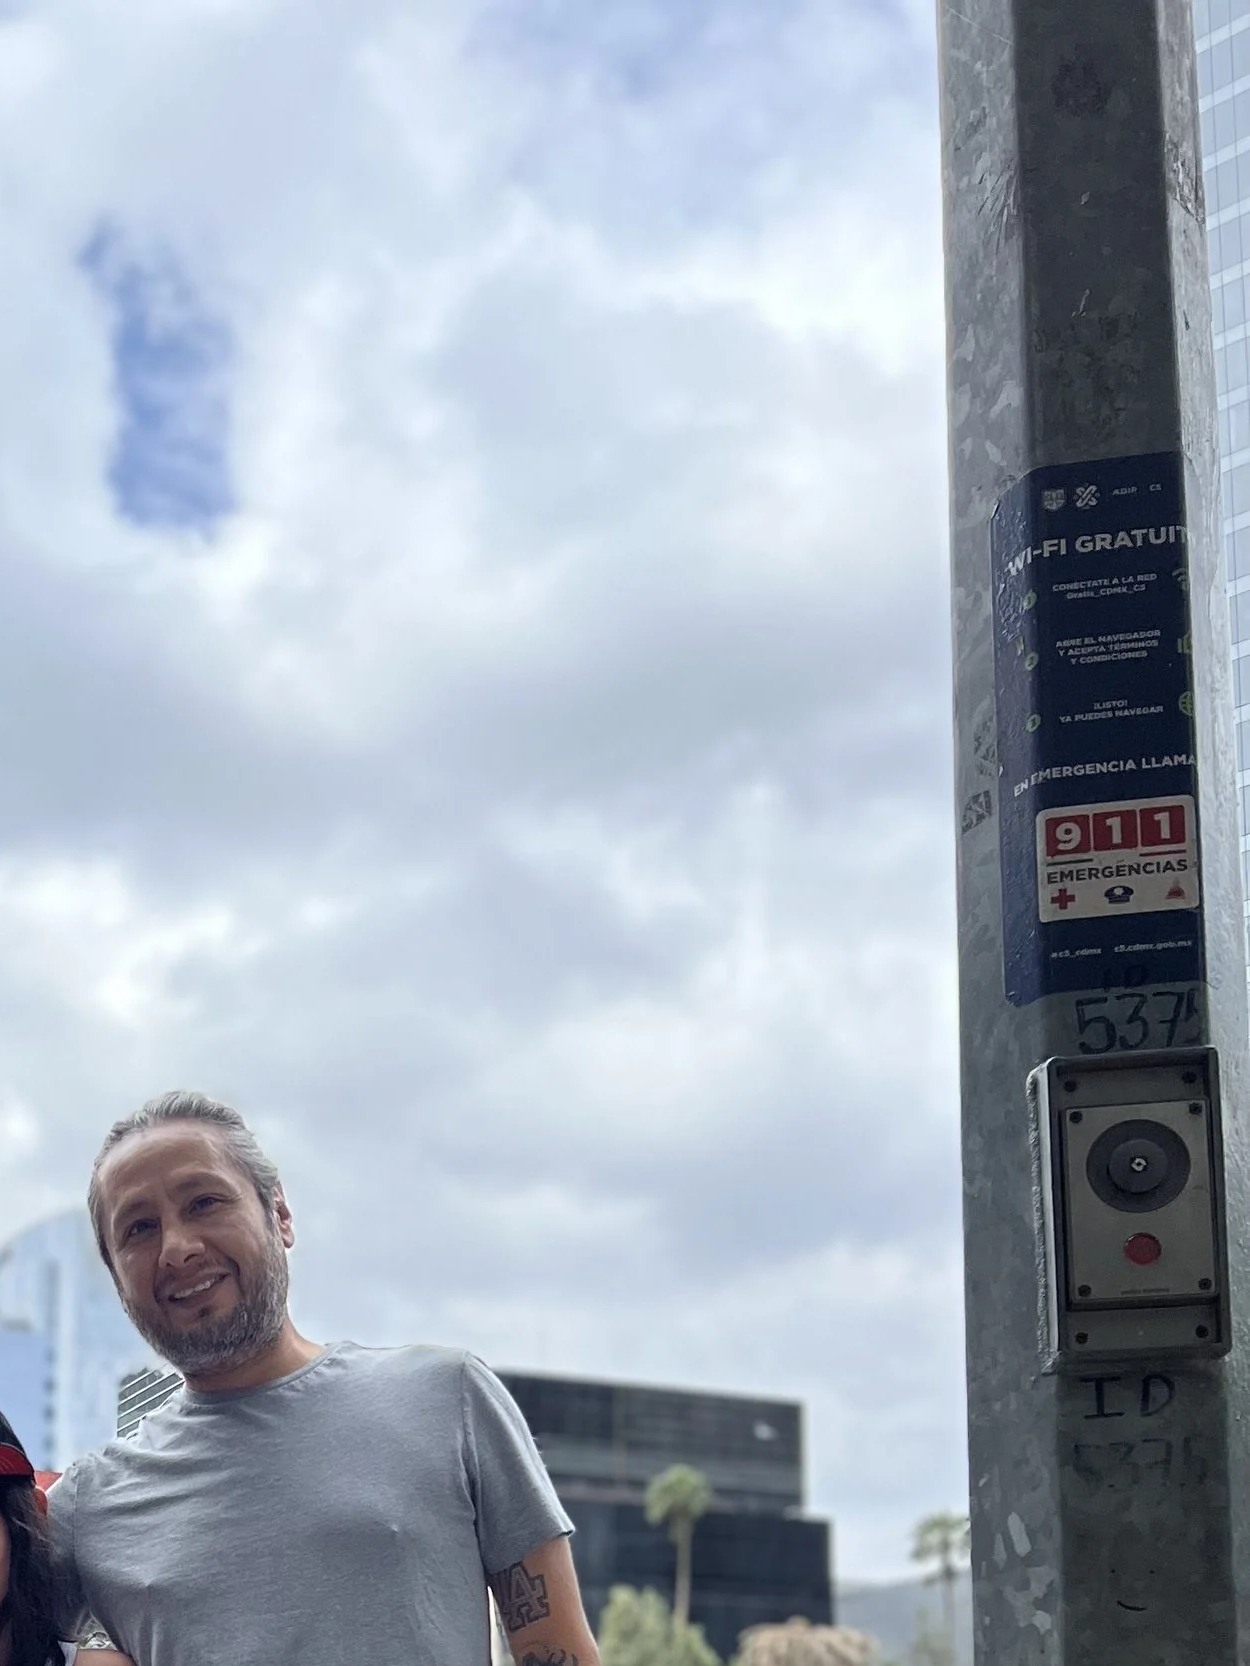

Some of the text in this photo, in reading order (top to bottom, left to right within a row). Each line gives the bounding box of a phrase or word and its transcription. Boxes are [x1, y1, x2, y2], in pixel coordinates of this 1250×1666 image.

[1004, 538, 1067, 575] WI-FI
[1111, 577, 1120, 585] A
[1137, 573, 1158, 581] RED
[1084, 636, 1097, 645] EL
[1098, 629, 1161, 643] NAVEGADOR
[1067, 645, 1106, 656] ACEPTA
[1079, 650, 1148, 664] CONDICIONES
[1059, 705, 1164, 723] YA PUEDES NAVEGAR
[1014, 778, 1028, 797] EN
[1030, 759, 1137, 786] EMERGENCIA
[1054, 811, 1171, 851] 911
[1046, 859, 1188, 885] EMERGENCIAS
[1080, 1373, 1176, 1420] ID
